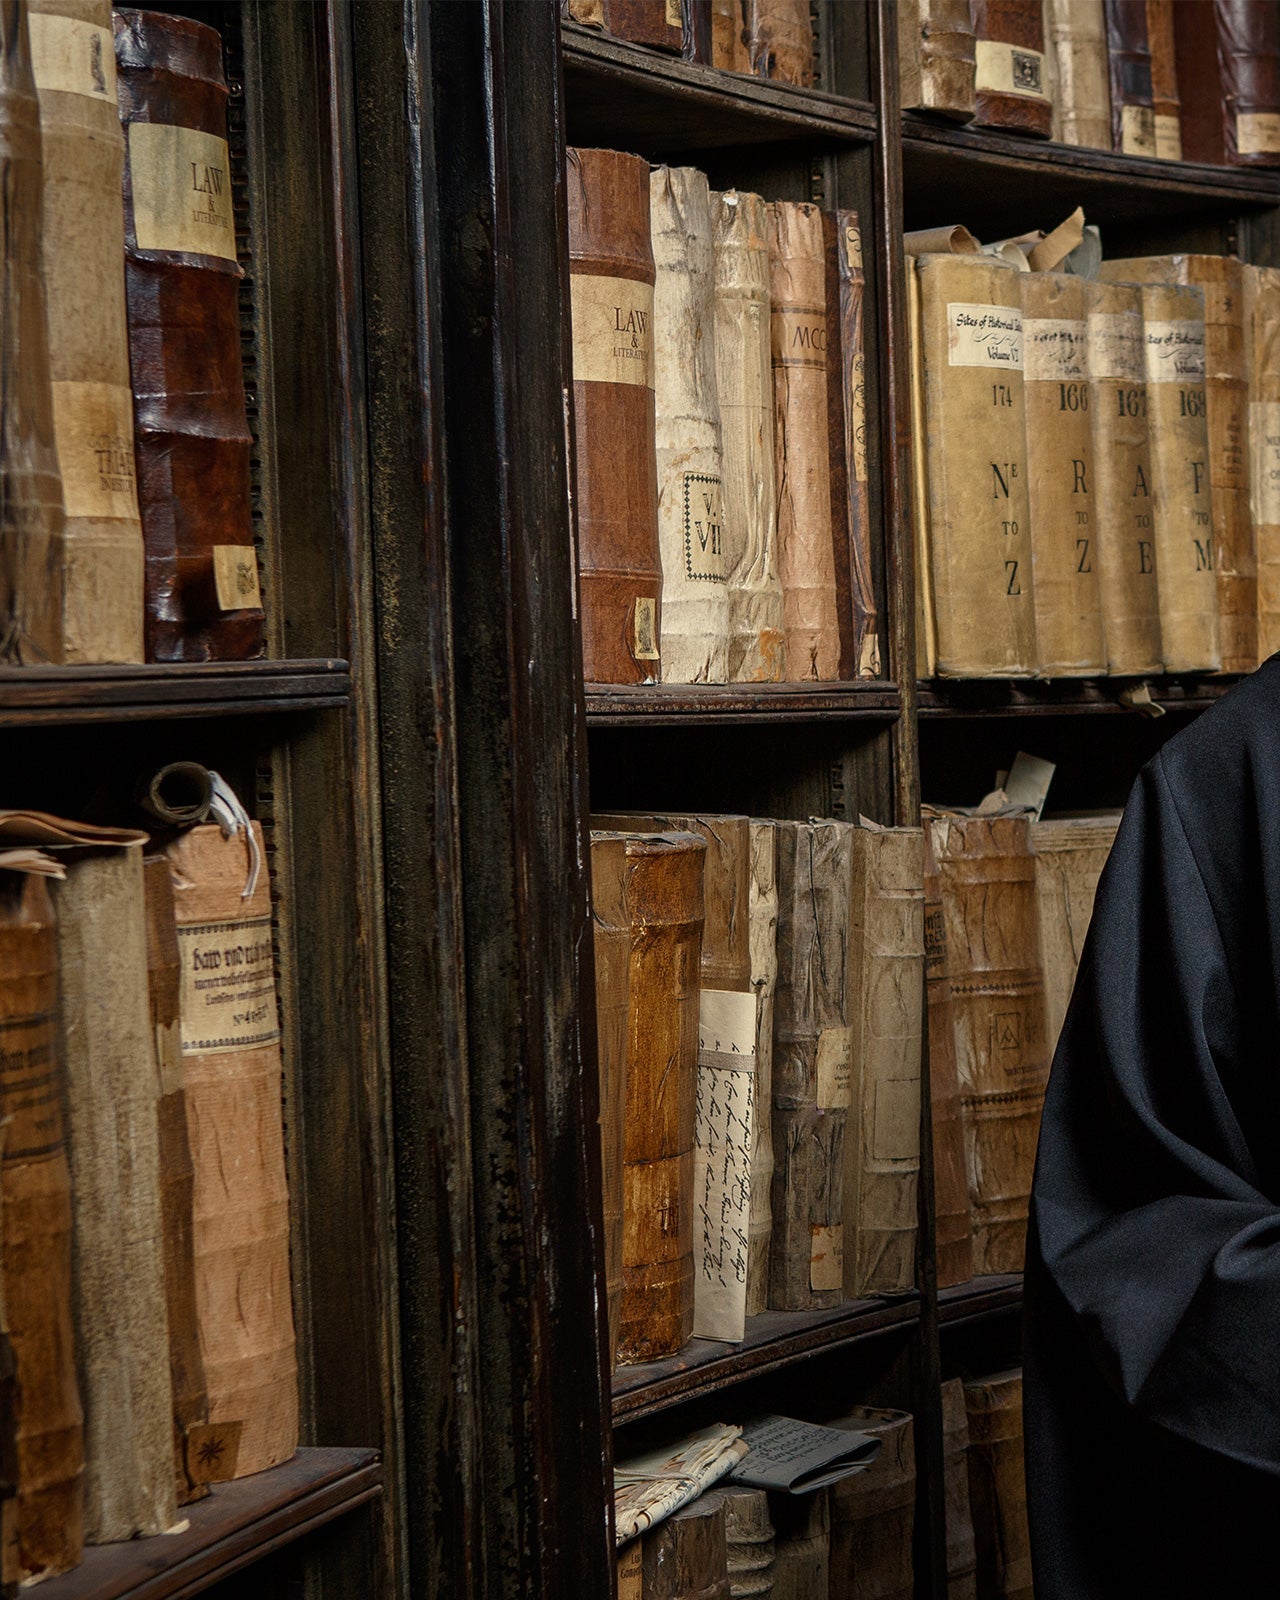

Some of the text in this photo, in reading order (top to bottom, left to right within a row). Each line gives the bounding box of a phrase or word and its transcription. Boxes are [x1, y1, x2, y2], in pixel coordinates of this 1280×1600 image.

[191, 162, 224, 196] LAW
[614, 306, 648, 335] LAW
[956, 313, 978, 327] Sites
[979, 315, 988, 330] of
[631, 334, 638, 349] &
[987, 346, 1010, 361] Volume
[992, 384, 1013, 407] 174
[1059, 383, 1089, 411] 166
[1117, 389, 1147, 417] 167
[1072, 460, 1087, 493] R
[1133, 464, 1148, 497] A
[1192, 462, 1204, 494] F
[1002, 521, 1019, 536] TO
[1076, 511, 1088, 525] TO
[1136, 514, 1150, 528] TO
[1076, 539, 1091, 574] Z
[1138, 541, 1153, 574] E
[1194, 539, 1213, 571] M
[1005, 561, 1021, 595] Z
